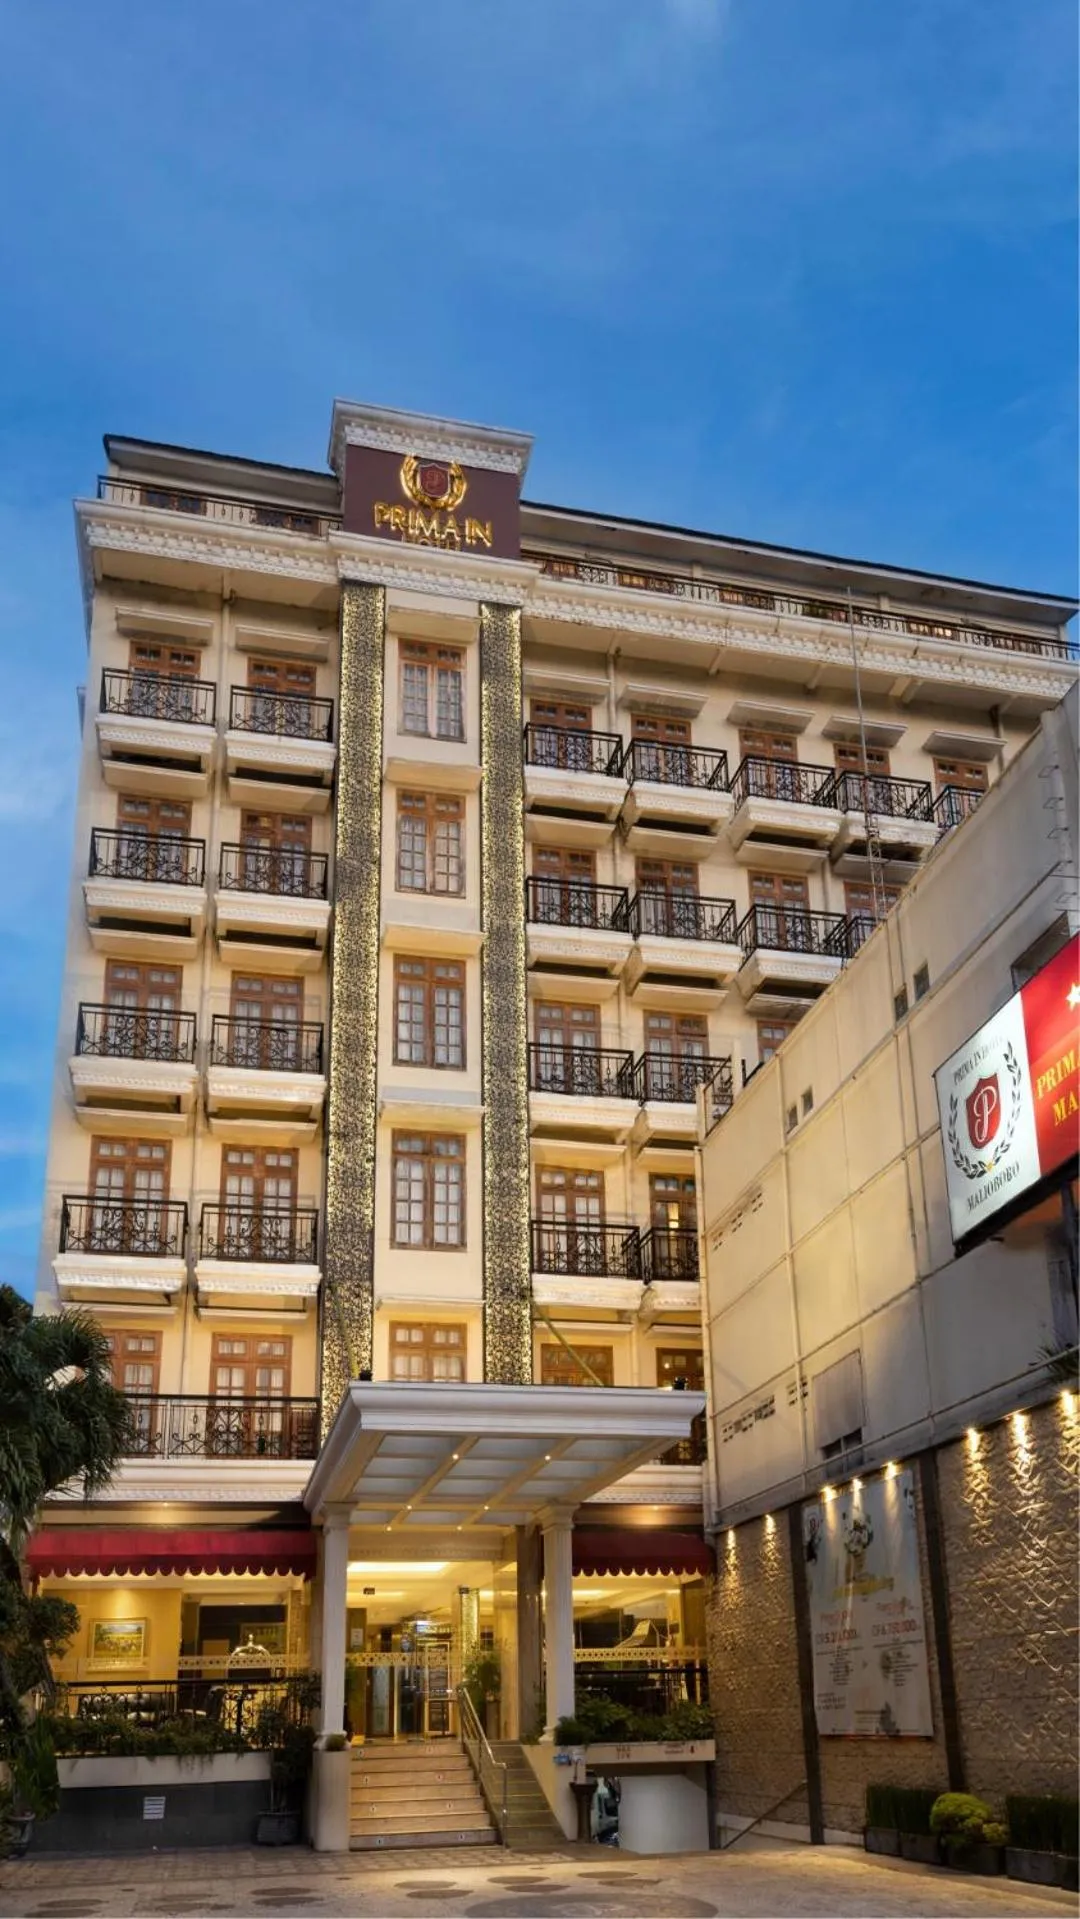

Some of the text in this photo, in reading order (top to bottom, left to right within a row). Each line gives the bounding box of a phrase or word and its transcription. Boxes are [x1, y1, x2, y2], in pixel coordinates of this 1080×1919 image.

[374, 502, 461, 540] PRIMA
[465, 517, 493, 547] IN
[1036, 1047, 1080, 1099] PRIM
